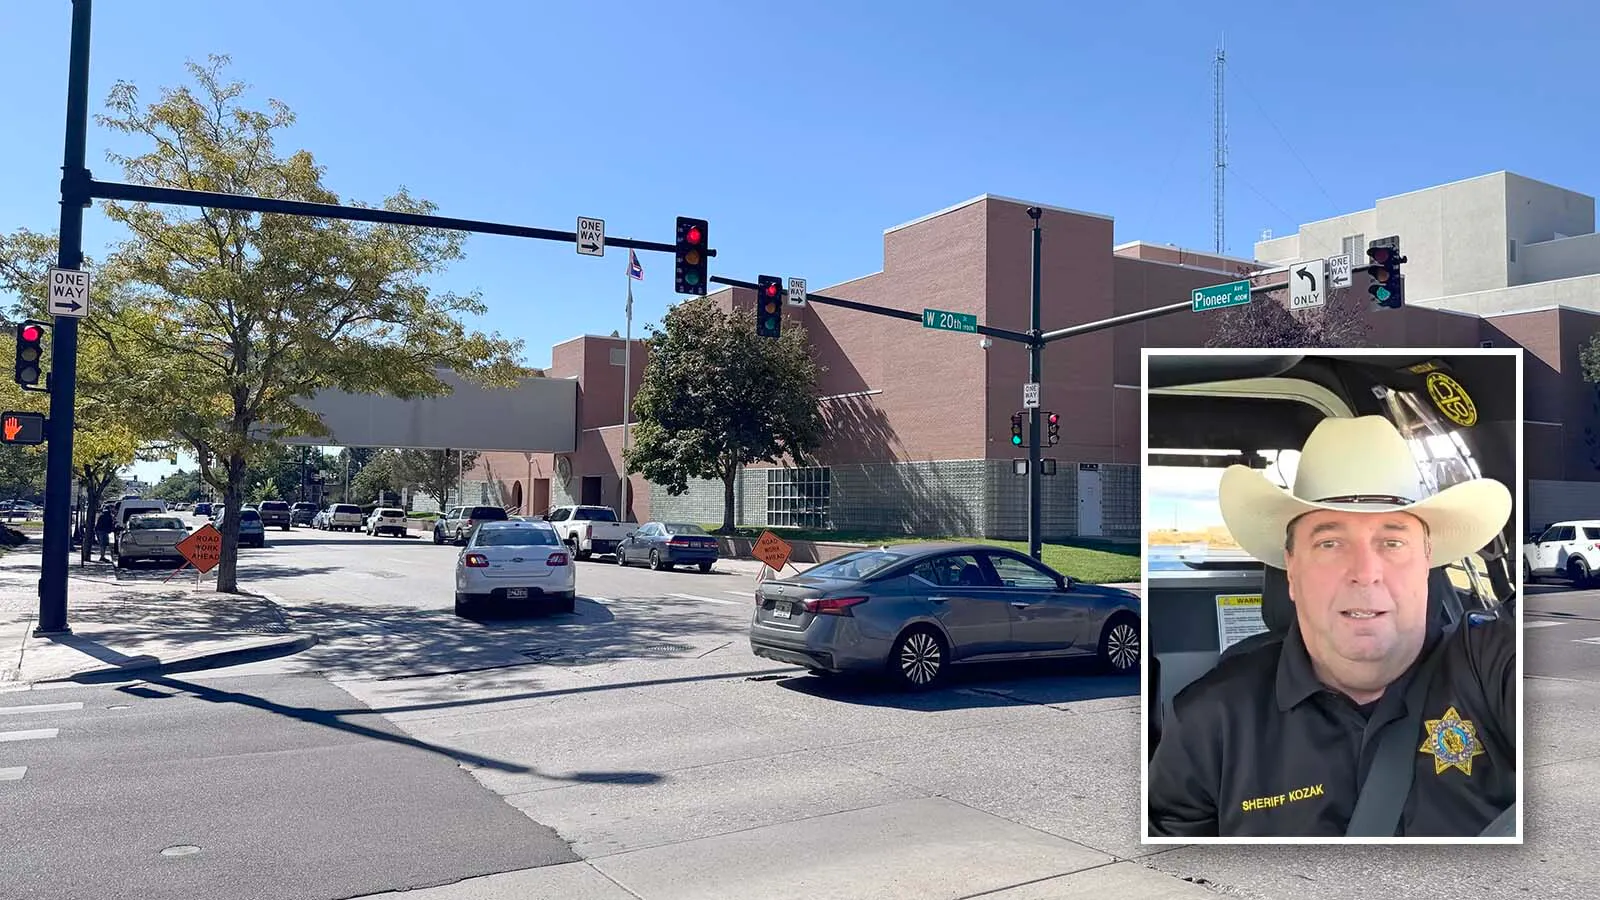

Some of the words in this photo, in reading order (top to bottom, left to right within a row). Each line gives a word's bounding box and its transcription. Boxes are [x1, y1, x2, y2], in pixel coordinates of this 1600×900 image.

[580, 220, 601, 231] ONE
[580, 230, 601, 241] WAY
[1331, 256, 1349, 267] ONE
[1331, 265, 1349, 275] WAY
[55, 273, 84, 286] ONE
[790, 279, 804, 288] ONE
[54, 285, 84, 298] WAY
[790, 288, 804, 296] WAY
[1195, 291, 1232, 308] Pioneer
[1293, 292, 1320, 305] ONLY
[926, 311, 935, 326] W
[940, 313, 962, 330] 20th
[196, 535, 219, 543] ROAD
[1242, 794, 1286, 811] SHERIFF
[1288, 783, 1325, 802] KOZAK
